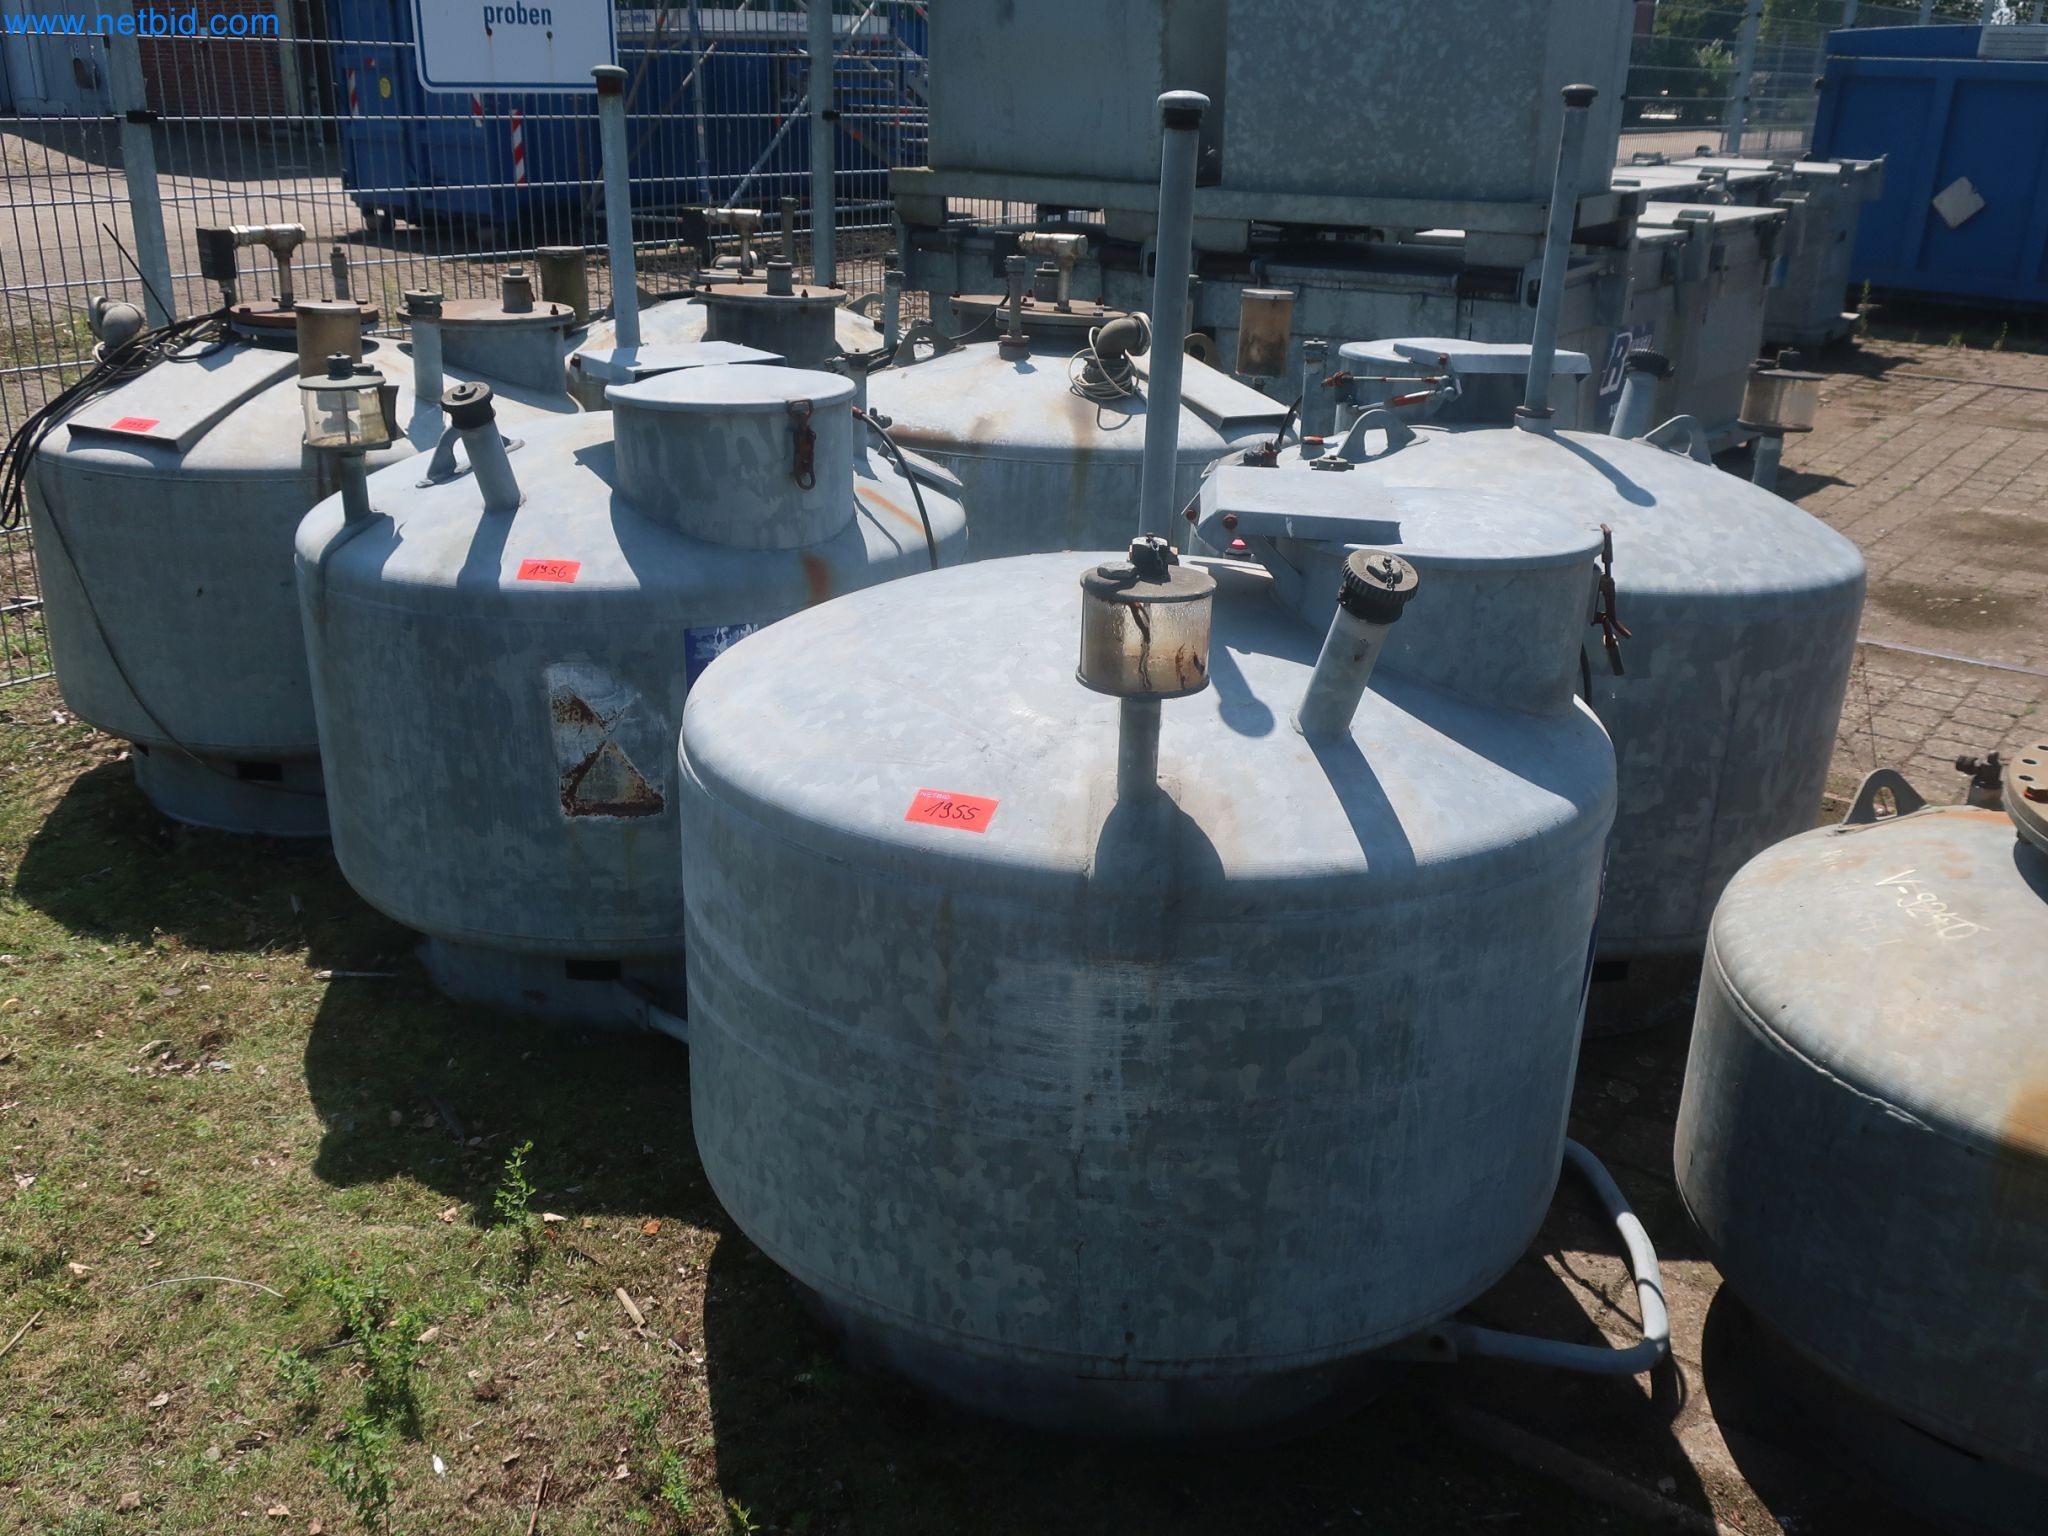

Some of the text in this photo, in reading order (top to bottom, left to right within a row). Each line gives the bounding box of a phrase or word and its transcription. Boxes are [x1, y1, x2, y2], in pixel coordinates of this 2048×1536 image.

[483, 0, 552, 29] proben
[527, 564, 568, 578] 1956
[923, 801, 981, 820] 1955
